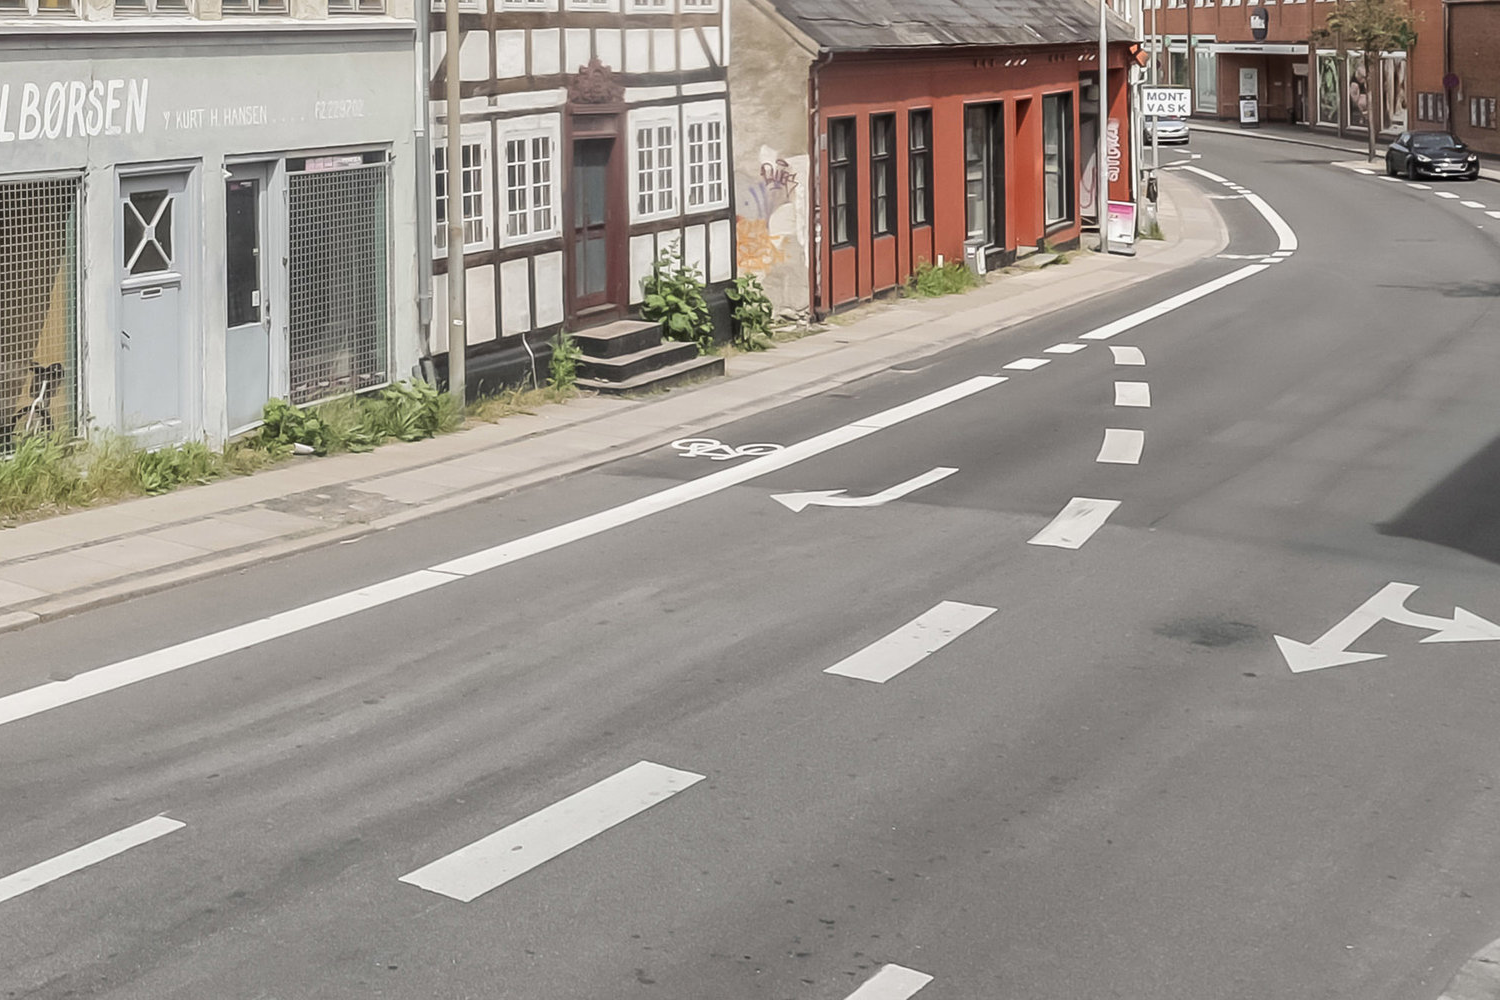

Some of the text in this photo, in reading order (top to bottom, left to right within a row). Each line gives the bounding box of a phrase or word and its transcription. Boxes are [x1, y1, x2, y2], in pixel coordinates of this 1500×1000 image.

[1147, 103, 1186, 113] VASK
[176, 109, 205, 129] KURT
[223, 105, 268, 126] HANSEN
